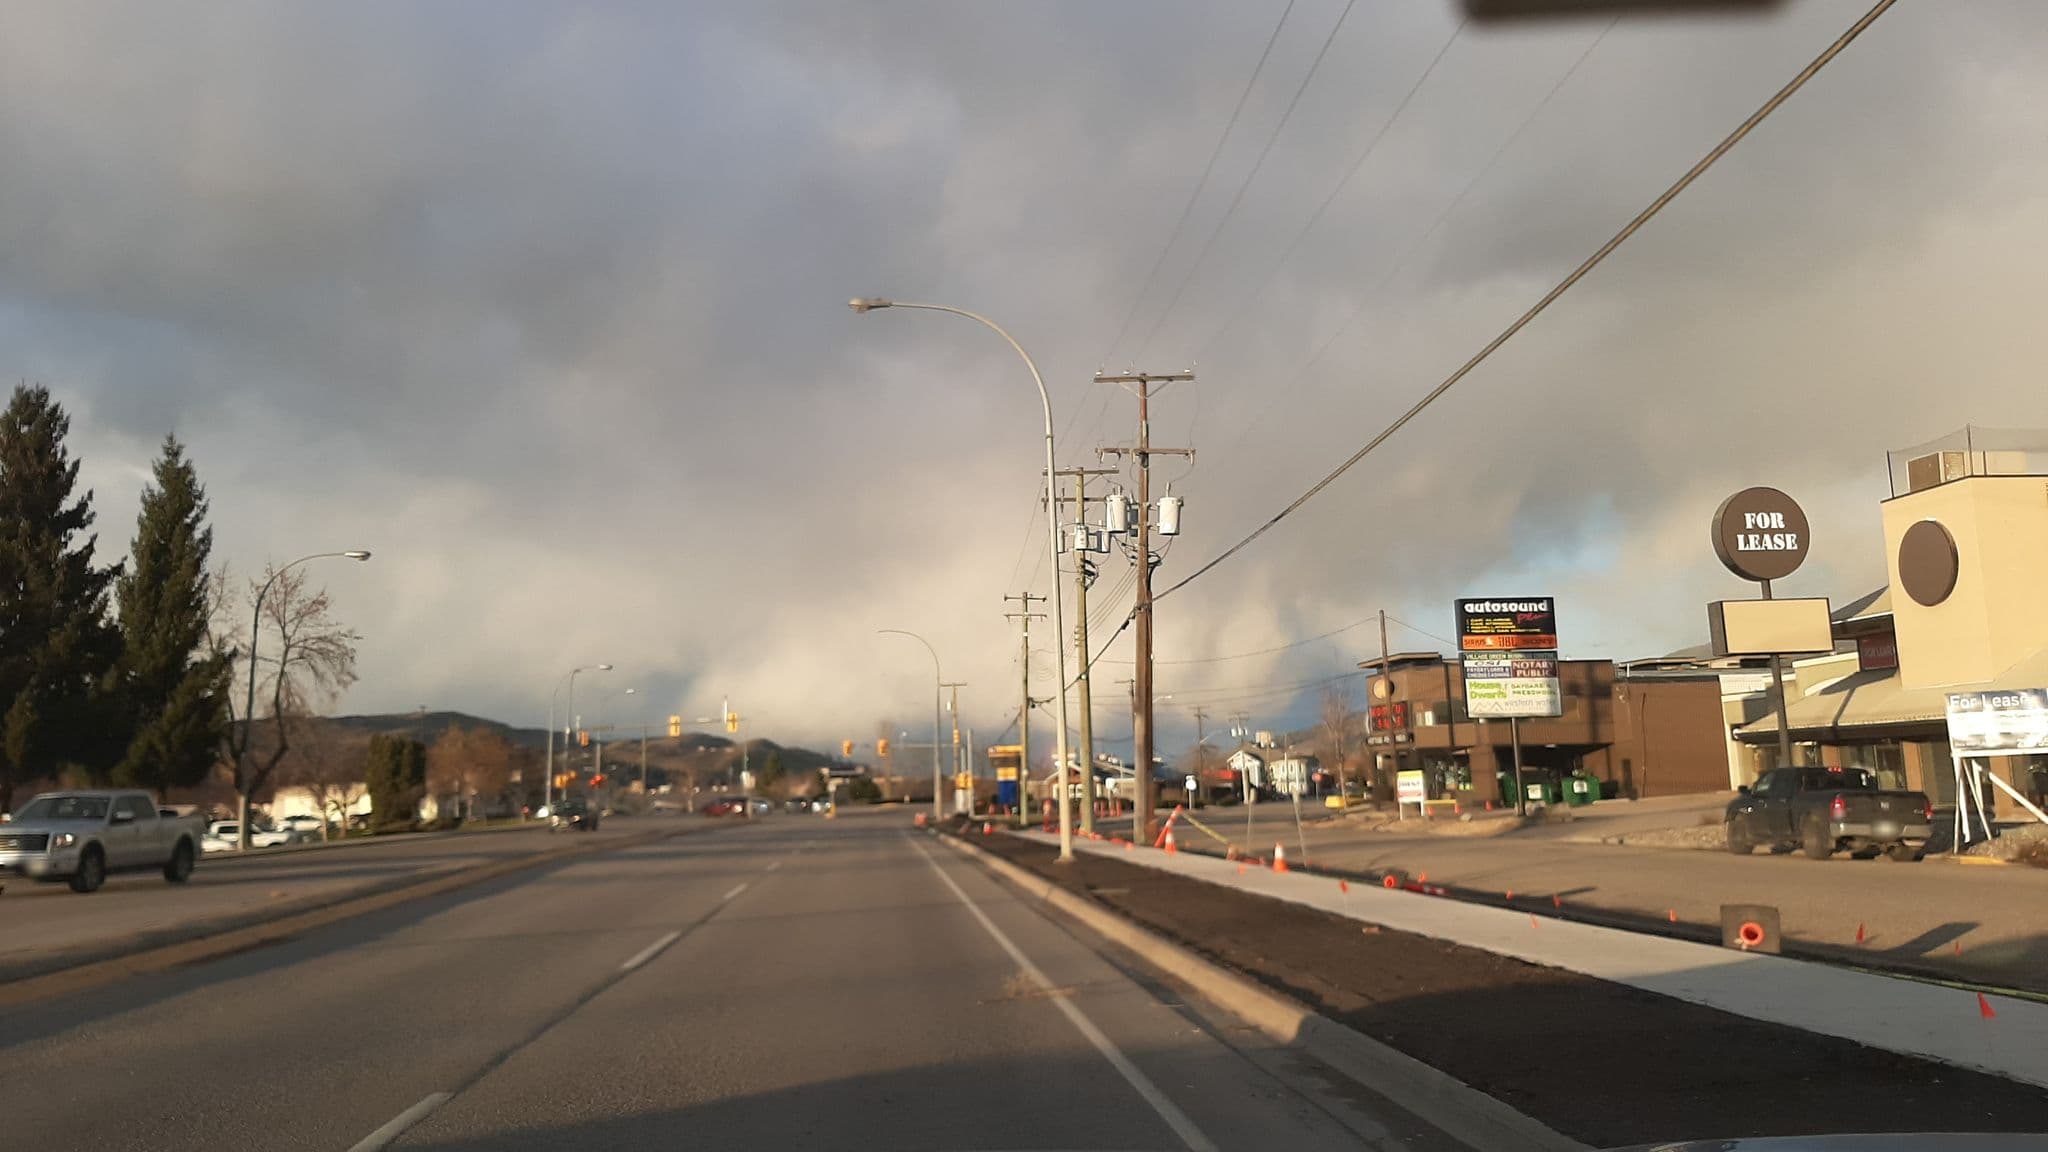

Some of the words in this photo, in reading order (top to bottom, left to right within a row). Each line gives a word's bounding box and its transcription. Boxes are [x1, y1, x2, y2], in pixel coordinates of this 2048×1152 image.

[1744, 512, 1785, 529] FOR
[1736, 533, 1798, 551] LEASE
[1464, 600, 1548, 614] autosound
[1512, 661, 1554, 669] NOTARY
[1516, 669, 1553, 677] PUBLIC
[1949, 695, 1977, 710] For
